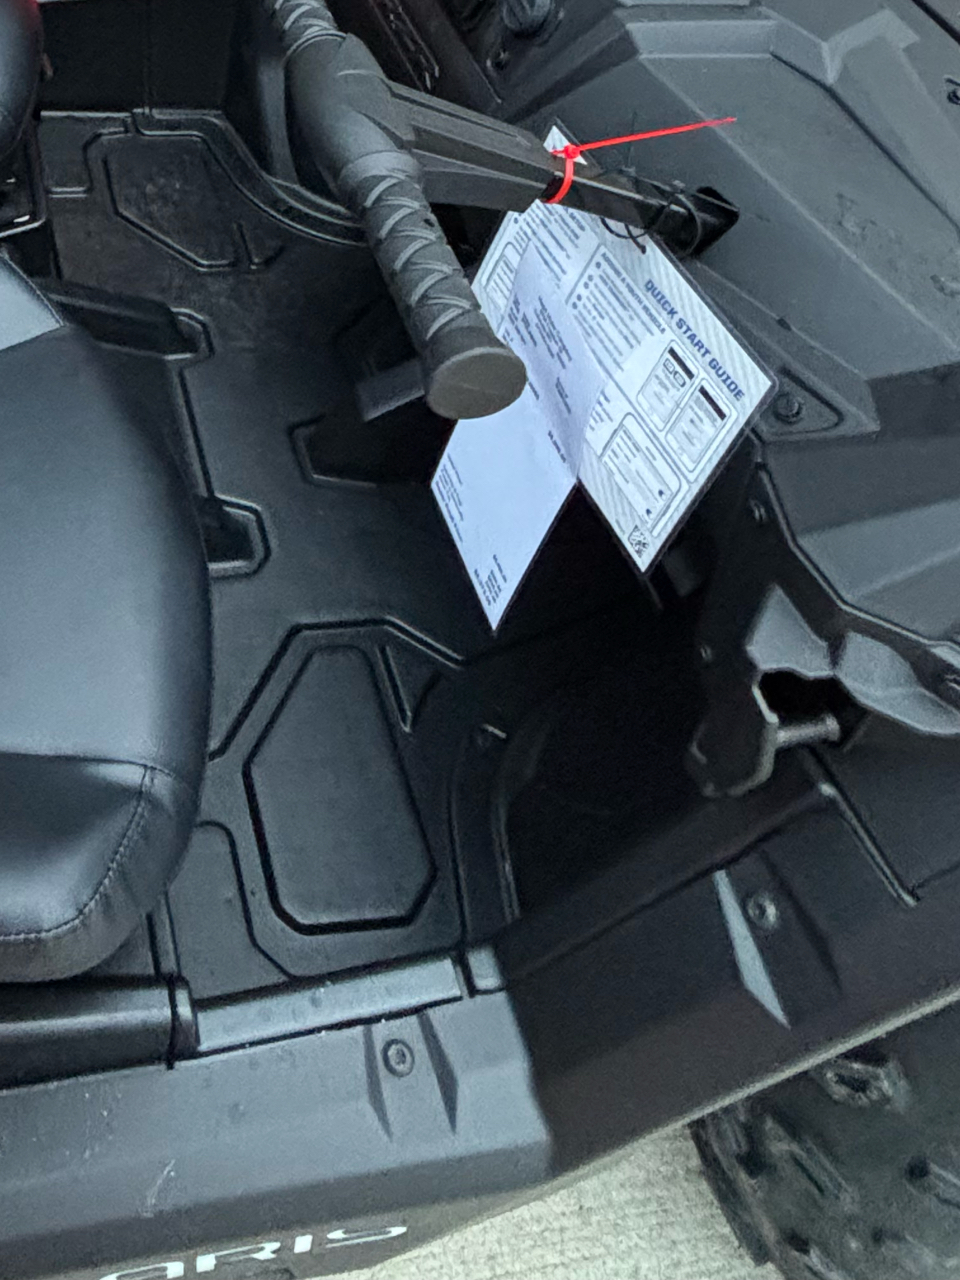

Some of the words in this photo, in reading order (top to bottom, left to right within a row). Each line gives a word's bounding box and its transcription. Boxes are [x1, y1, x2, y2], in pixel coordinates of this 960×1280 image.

[644, 278, 678, 319] QUICK
[675, 317, 711, 358] START
[708, 357, 745, 401] GUIDE
